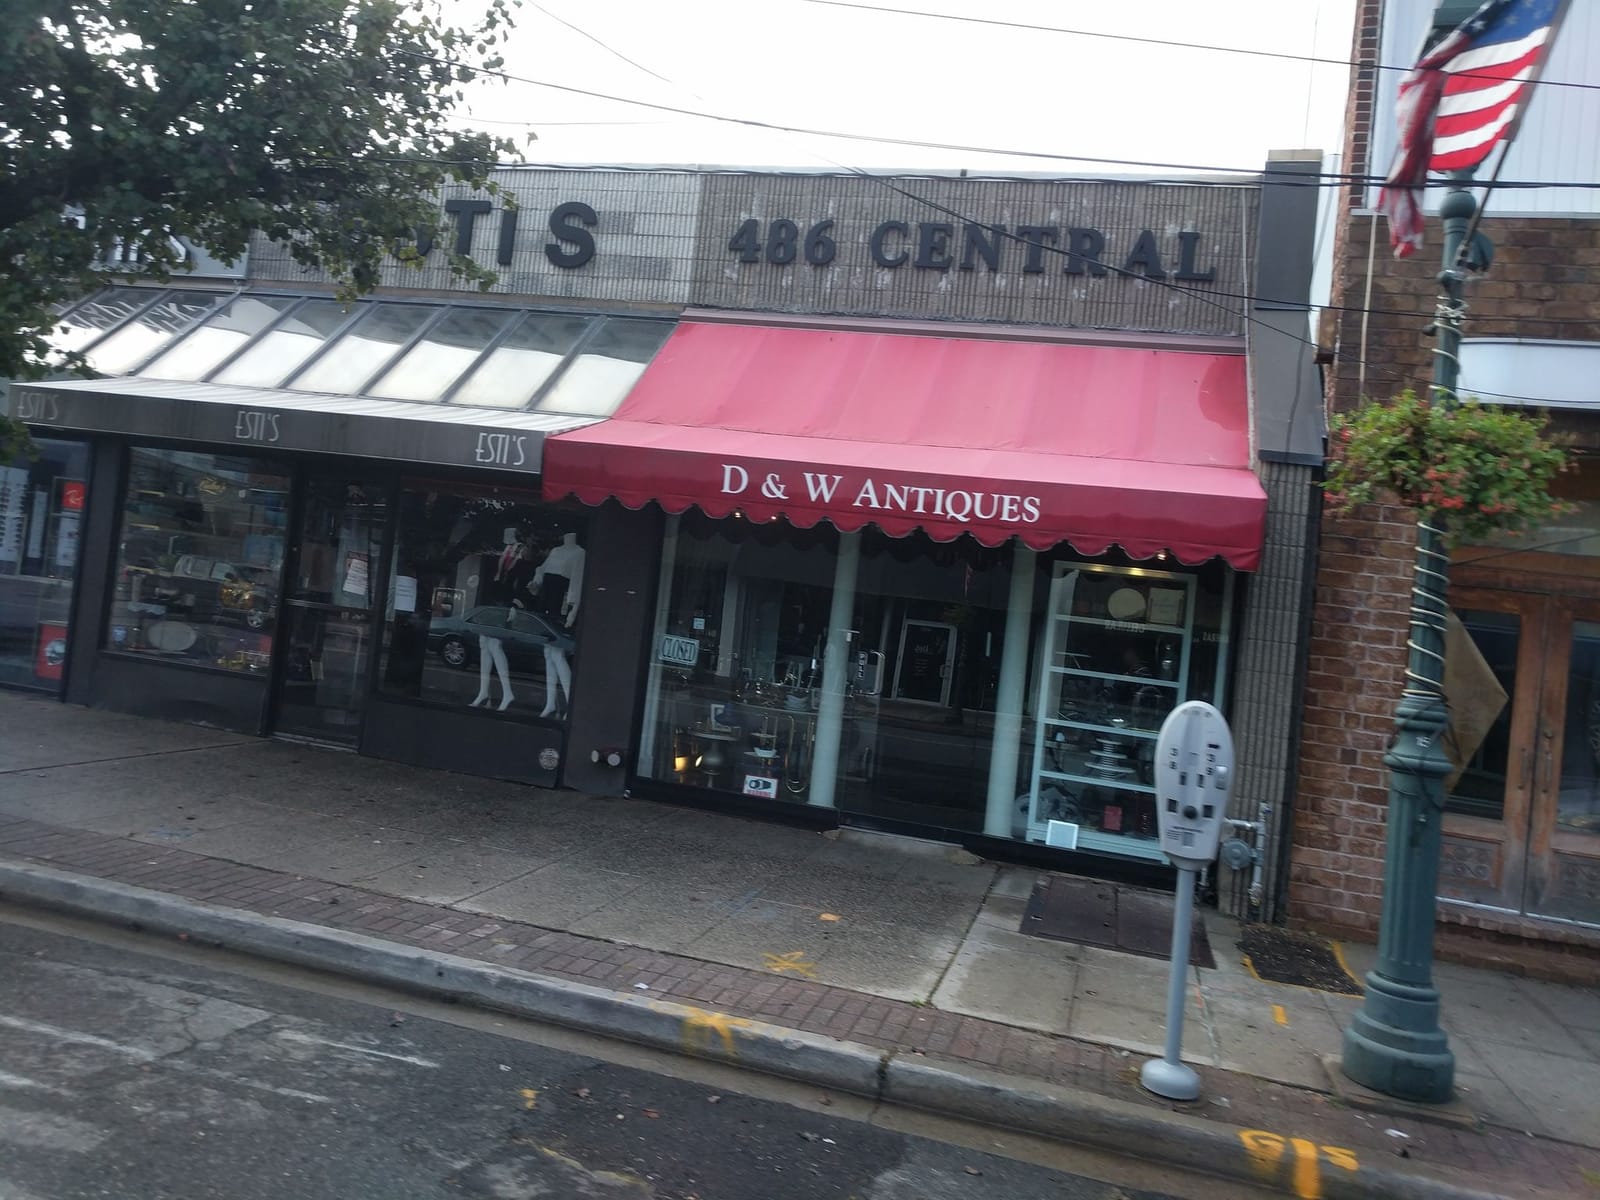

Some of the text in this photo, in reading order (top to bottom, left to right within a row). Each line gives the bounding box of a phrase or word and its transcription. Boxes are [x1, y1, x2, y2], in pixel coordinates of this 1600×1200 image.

[728, 217, 1216, 282] 486 CENTRAL
[235, 410, 280, 442] ESTI'S
[475, 432, 527, 466] ESTI'S
[721, 463, 1042, 524] D & W ANTIQUES
